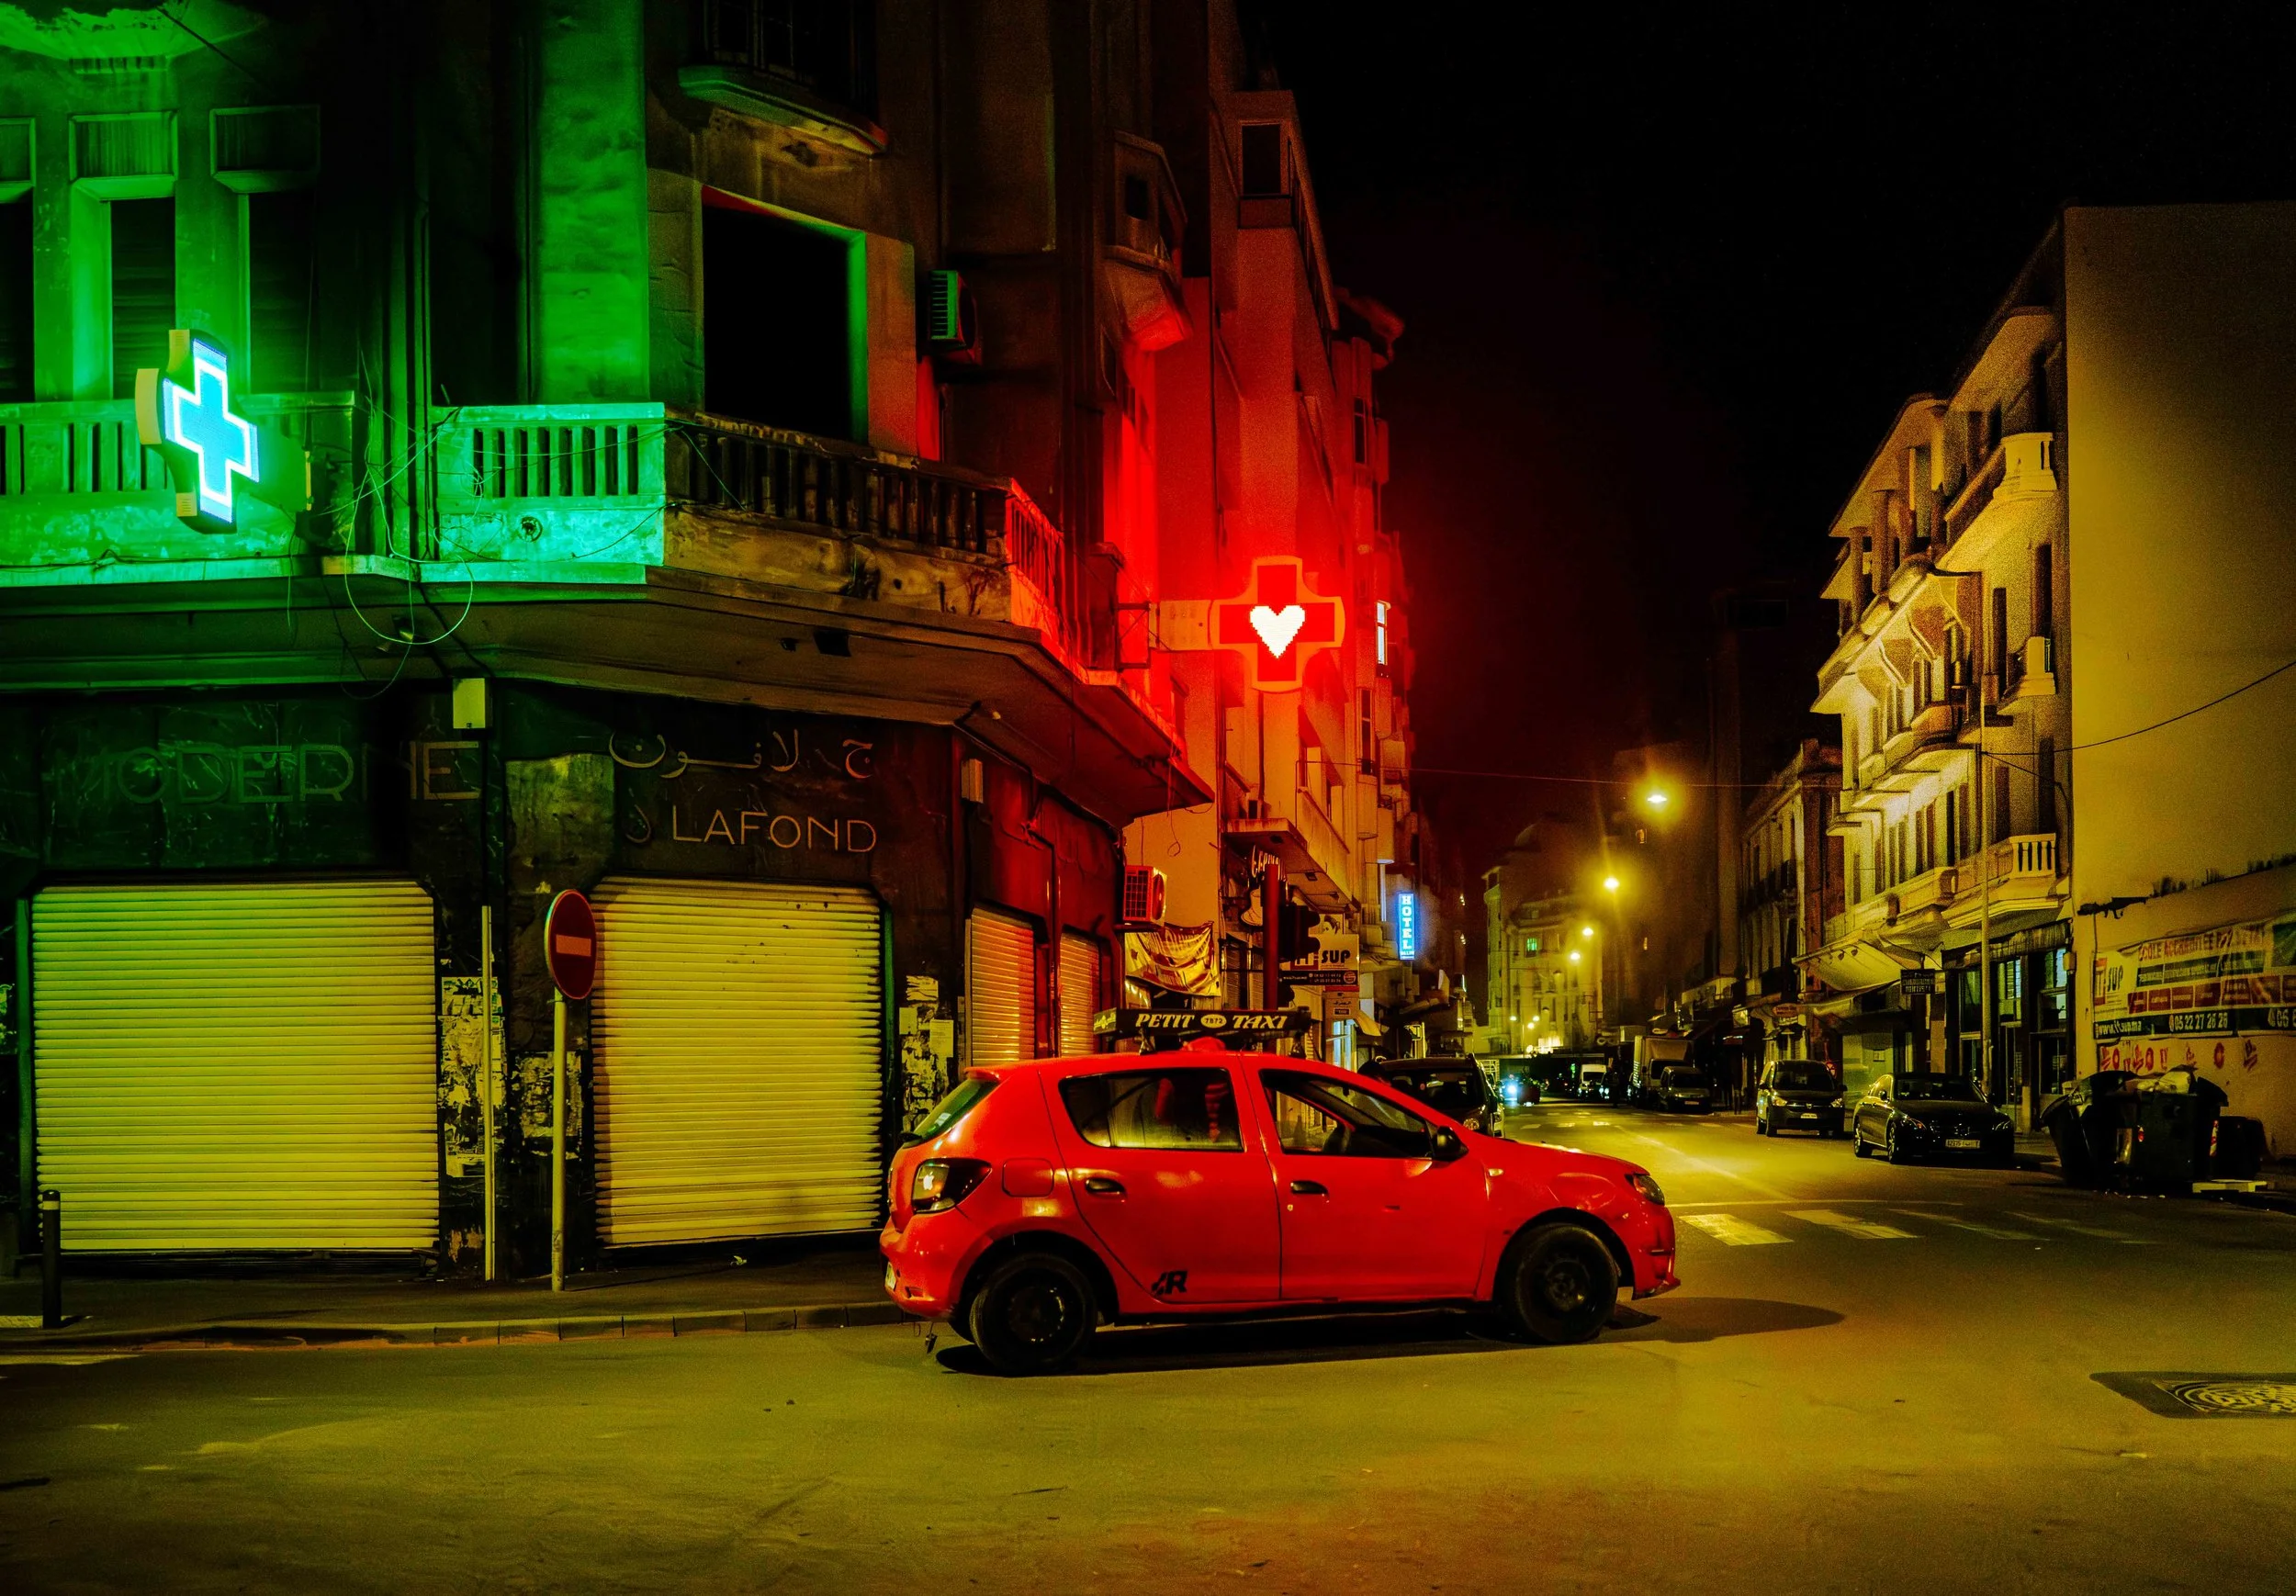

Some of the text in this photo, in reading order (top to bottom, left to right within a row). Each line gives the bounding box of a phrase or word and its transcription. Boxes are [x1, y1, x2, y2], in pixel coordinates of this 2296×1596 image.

[672, 804, 877, 853] LAFOND
[1401, 895, 1412, 950] HOTEL
[1322, 950, 1351, 964] SUP
[2107, 965, 2123, 992] SUP
[1135, 1014, 1195, 1028] PETIT
[1232, 1015, 1288, 1029] TAXI
